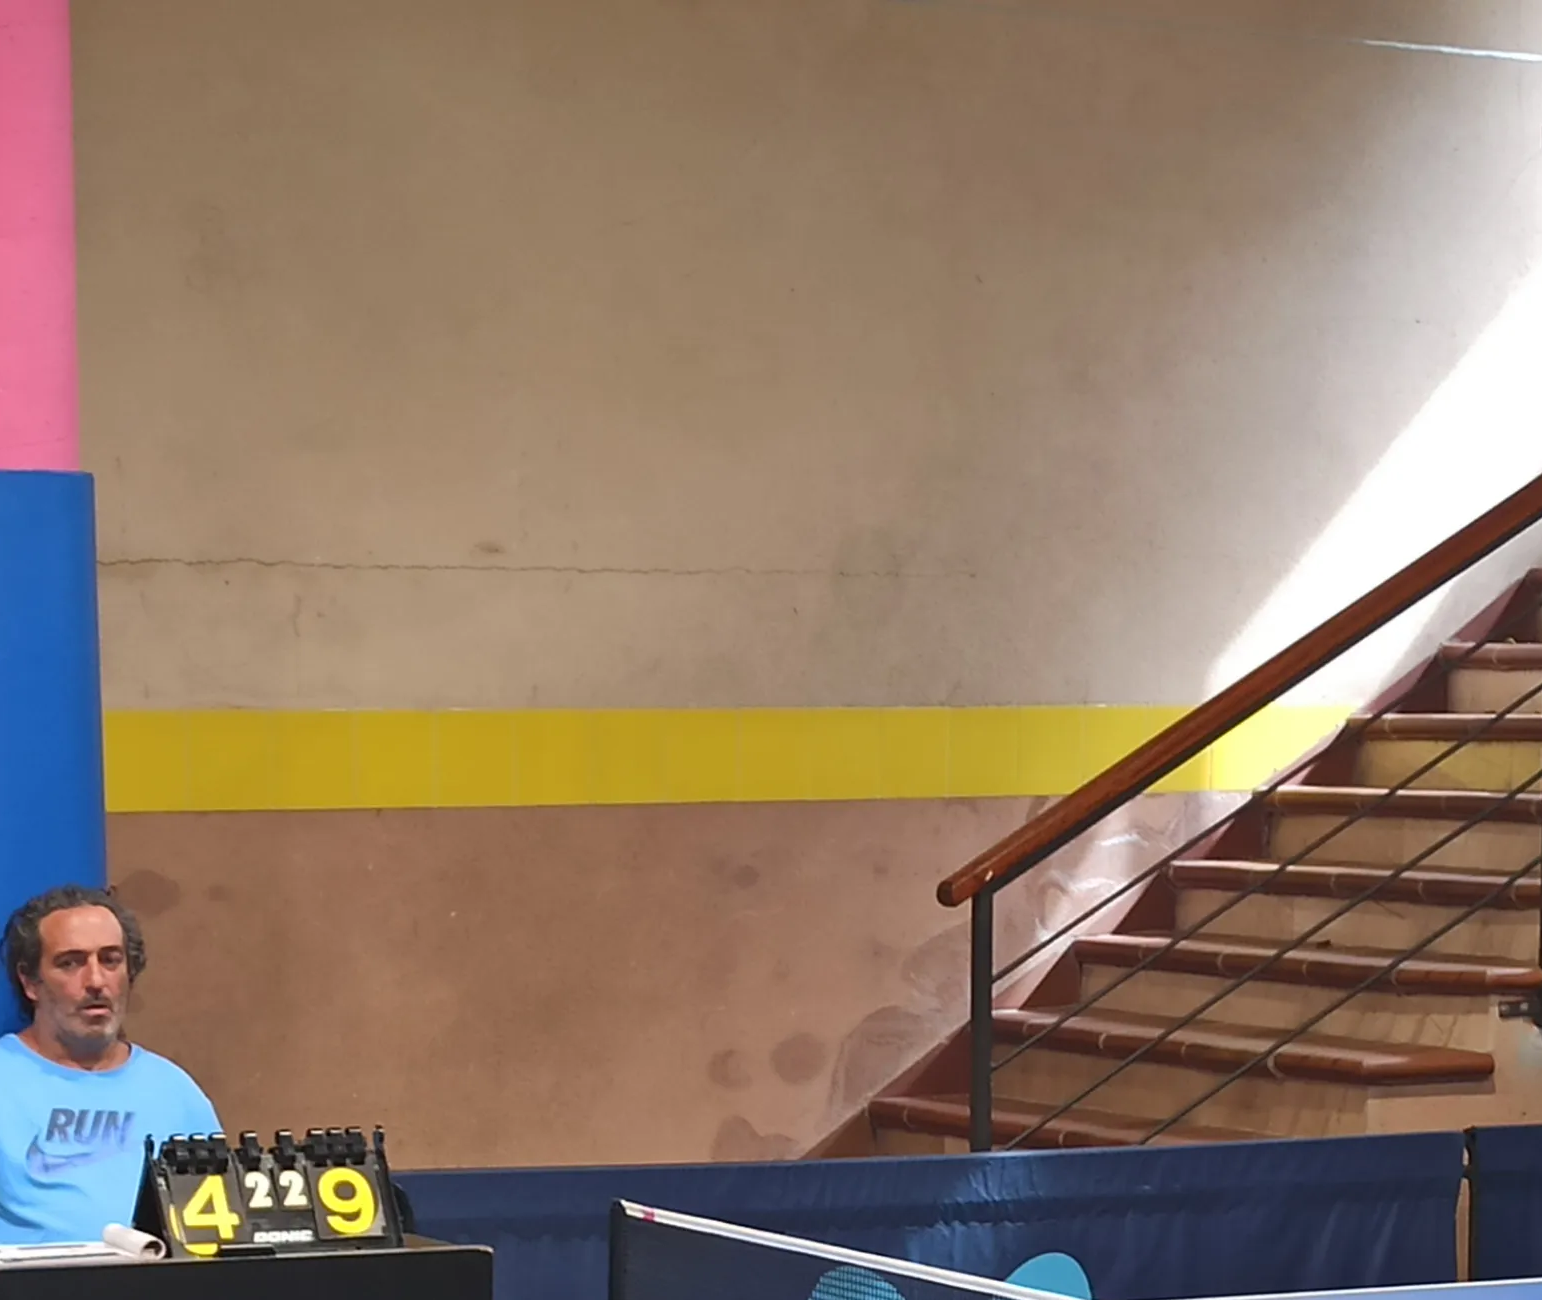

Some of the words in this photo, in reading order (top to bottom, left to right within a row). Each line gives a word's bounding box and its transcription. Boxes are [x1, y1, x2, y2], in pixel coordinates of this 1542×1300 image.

[45, 1108, 136, 1145] RUN
[182, 1174, 240, 1240] 4
[245, 1171, 273, 1208] 2
[279, 1170, 308, 1206] 2
[318, 1166, 375, 1234] 9
